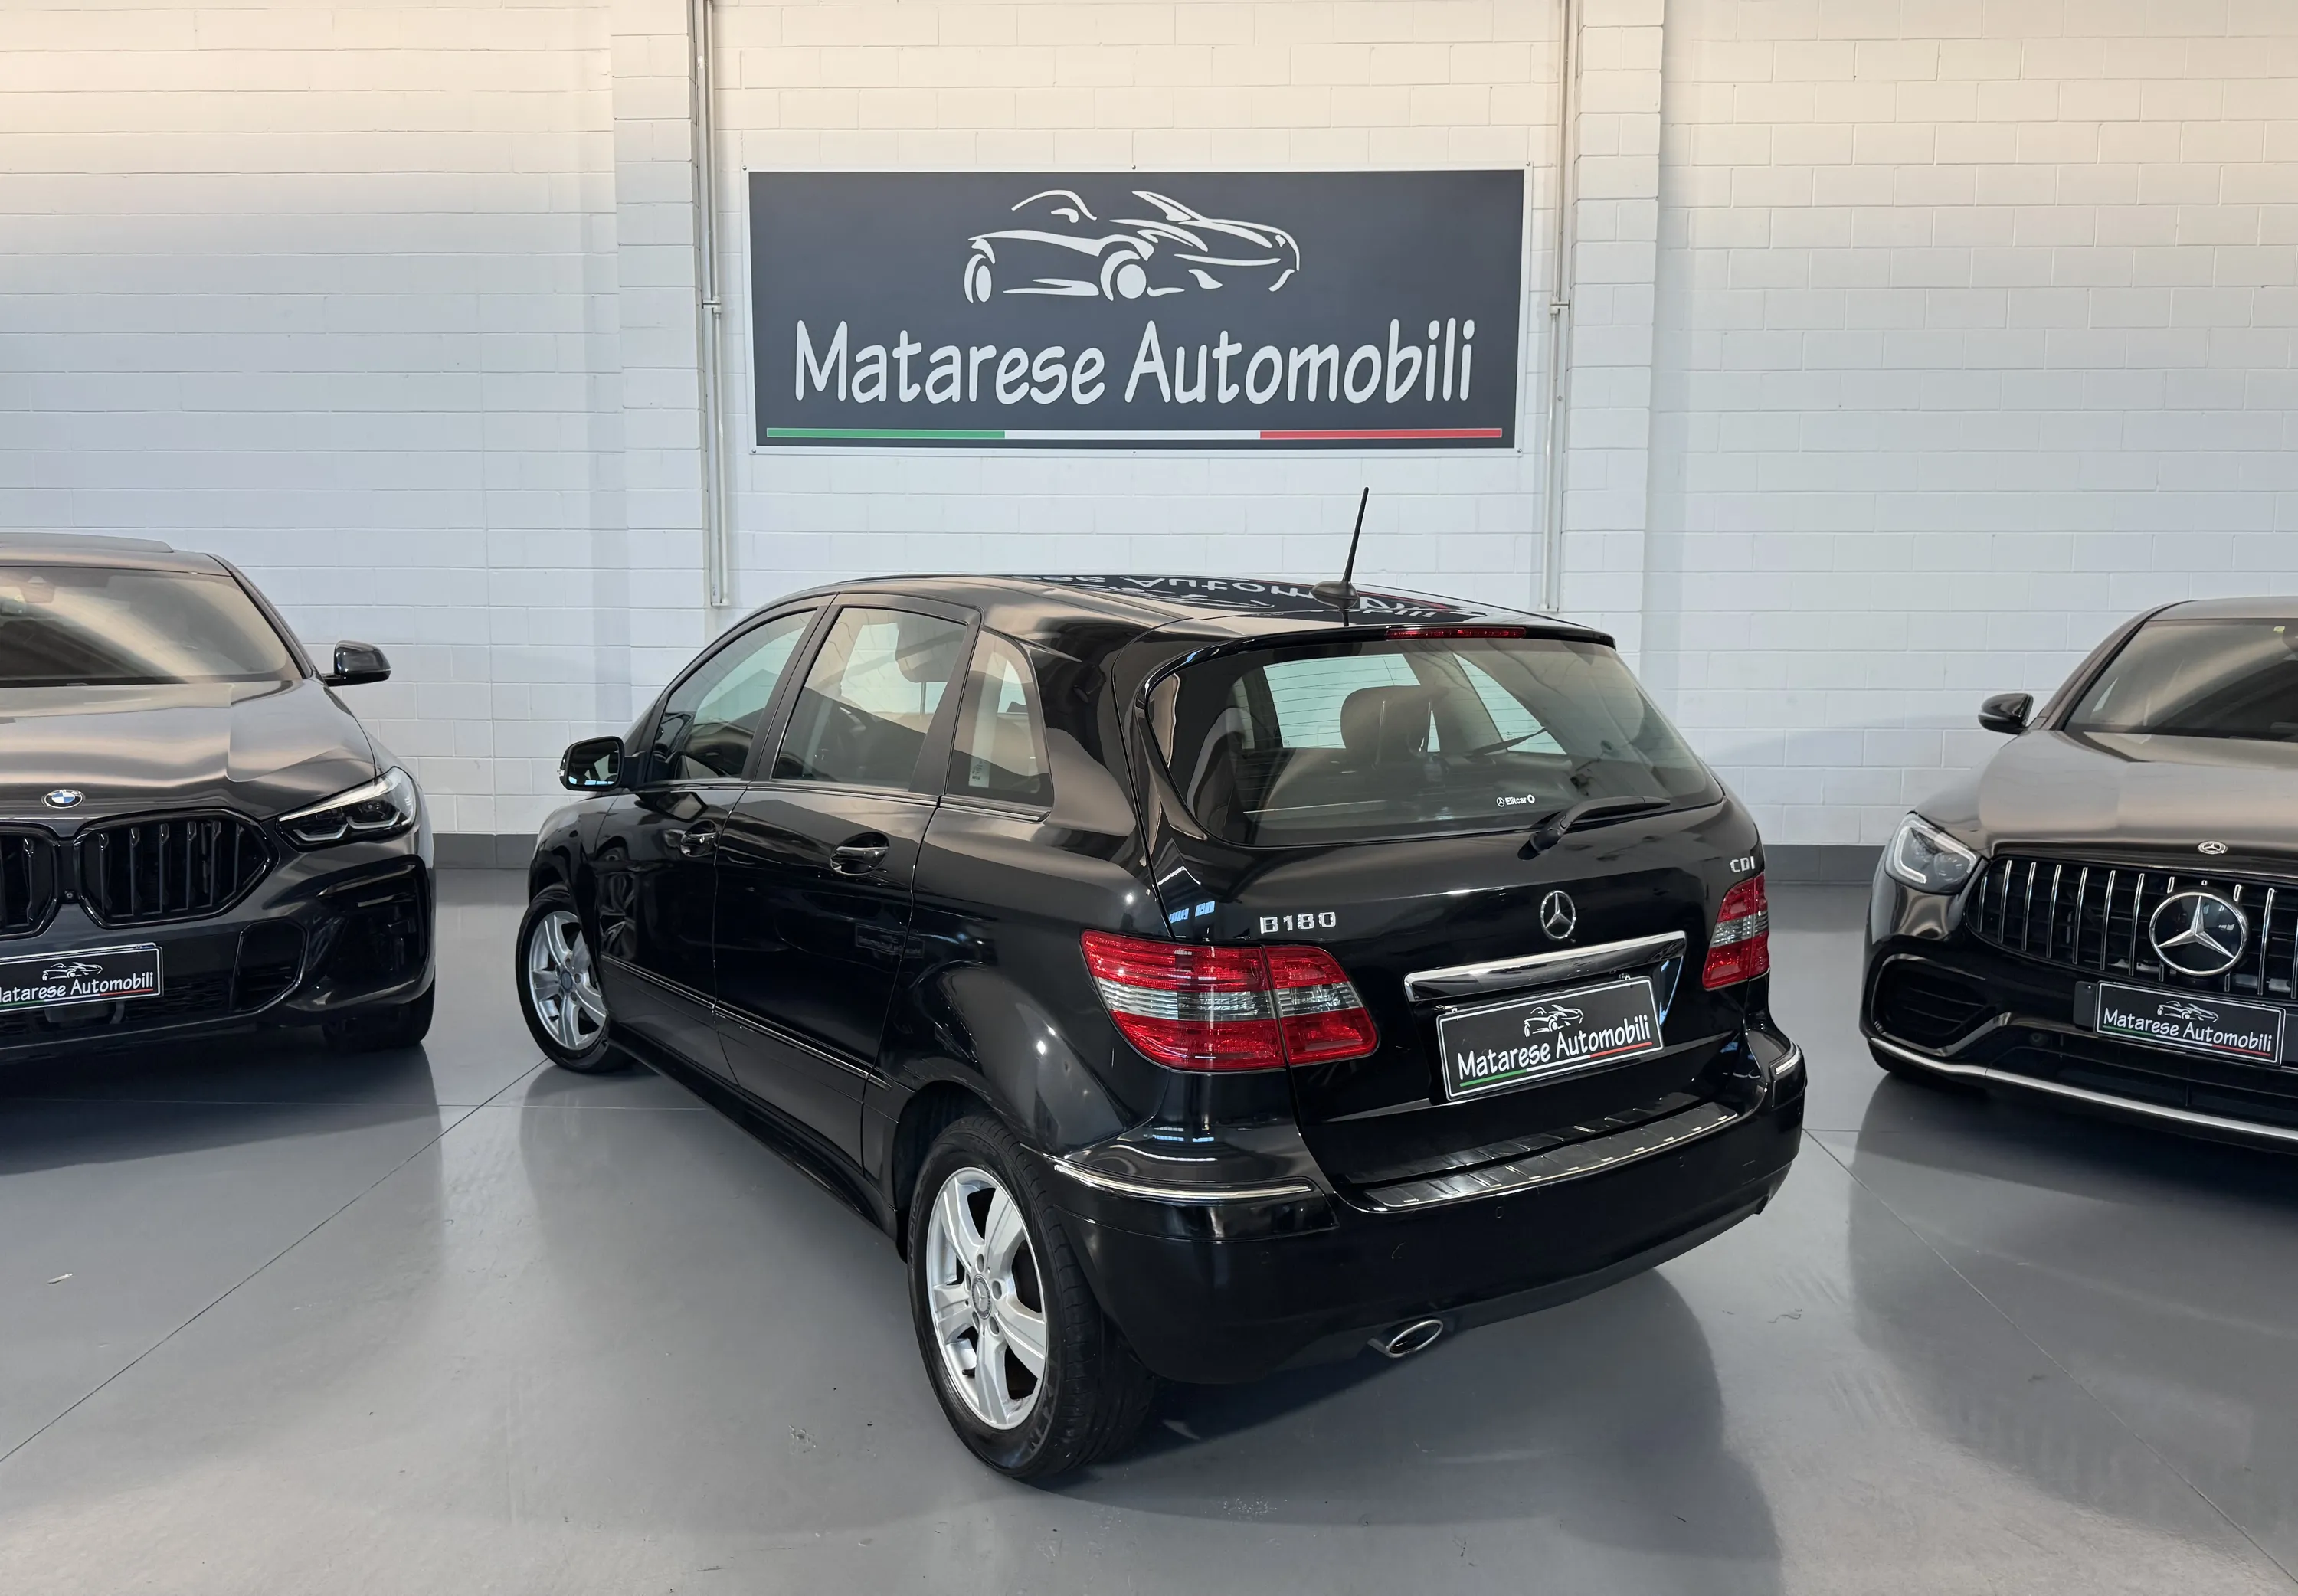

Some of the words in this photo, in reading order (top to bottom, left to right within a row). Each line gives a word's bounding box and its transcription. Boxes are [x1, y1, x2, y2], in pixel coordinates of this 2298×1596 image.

[795, 319, 1105, 405] Matarese
[1124, 317, 1476, 405] Automobili
[1730, 855, 1755, 873] CDI
[1260, 911, 1336, 934] B180
[70, 971, 154, 996] Automobili
[1457, 1042, 1551, 1080] Matarese
[1556, 1014, 1651, 1058] Automobili
[2103, 1007, 2179, 1036] Matarese
[2183, 1022, 2273, 1052] Automobili
